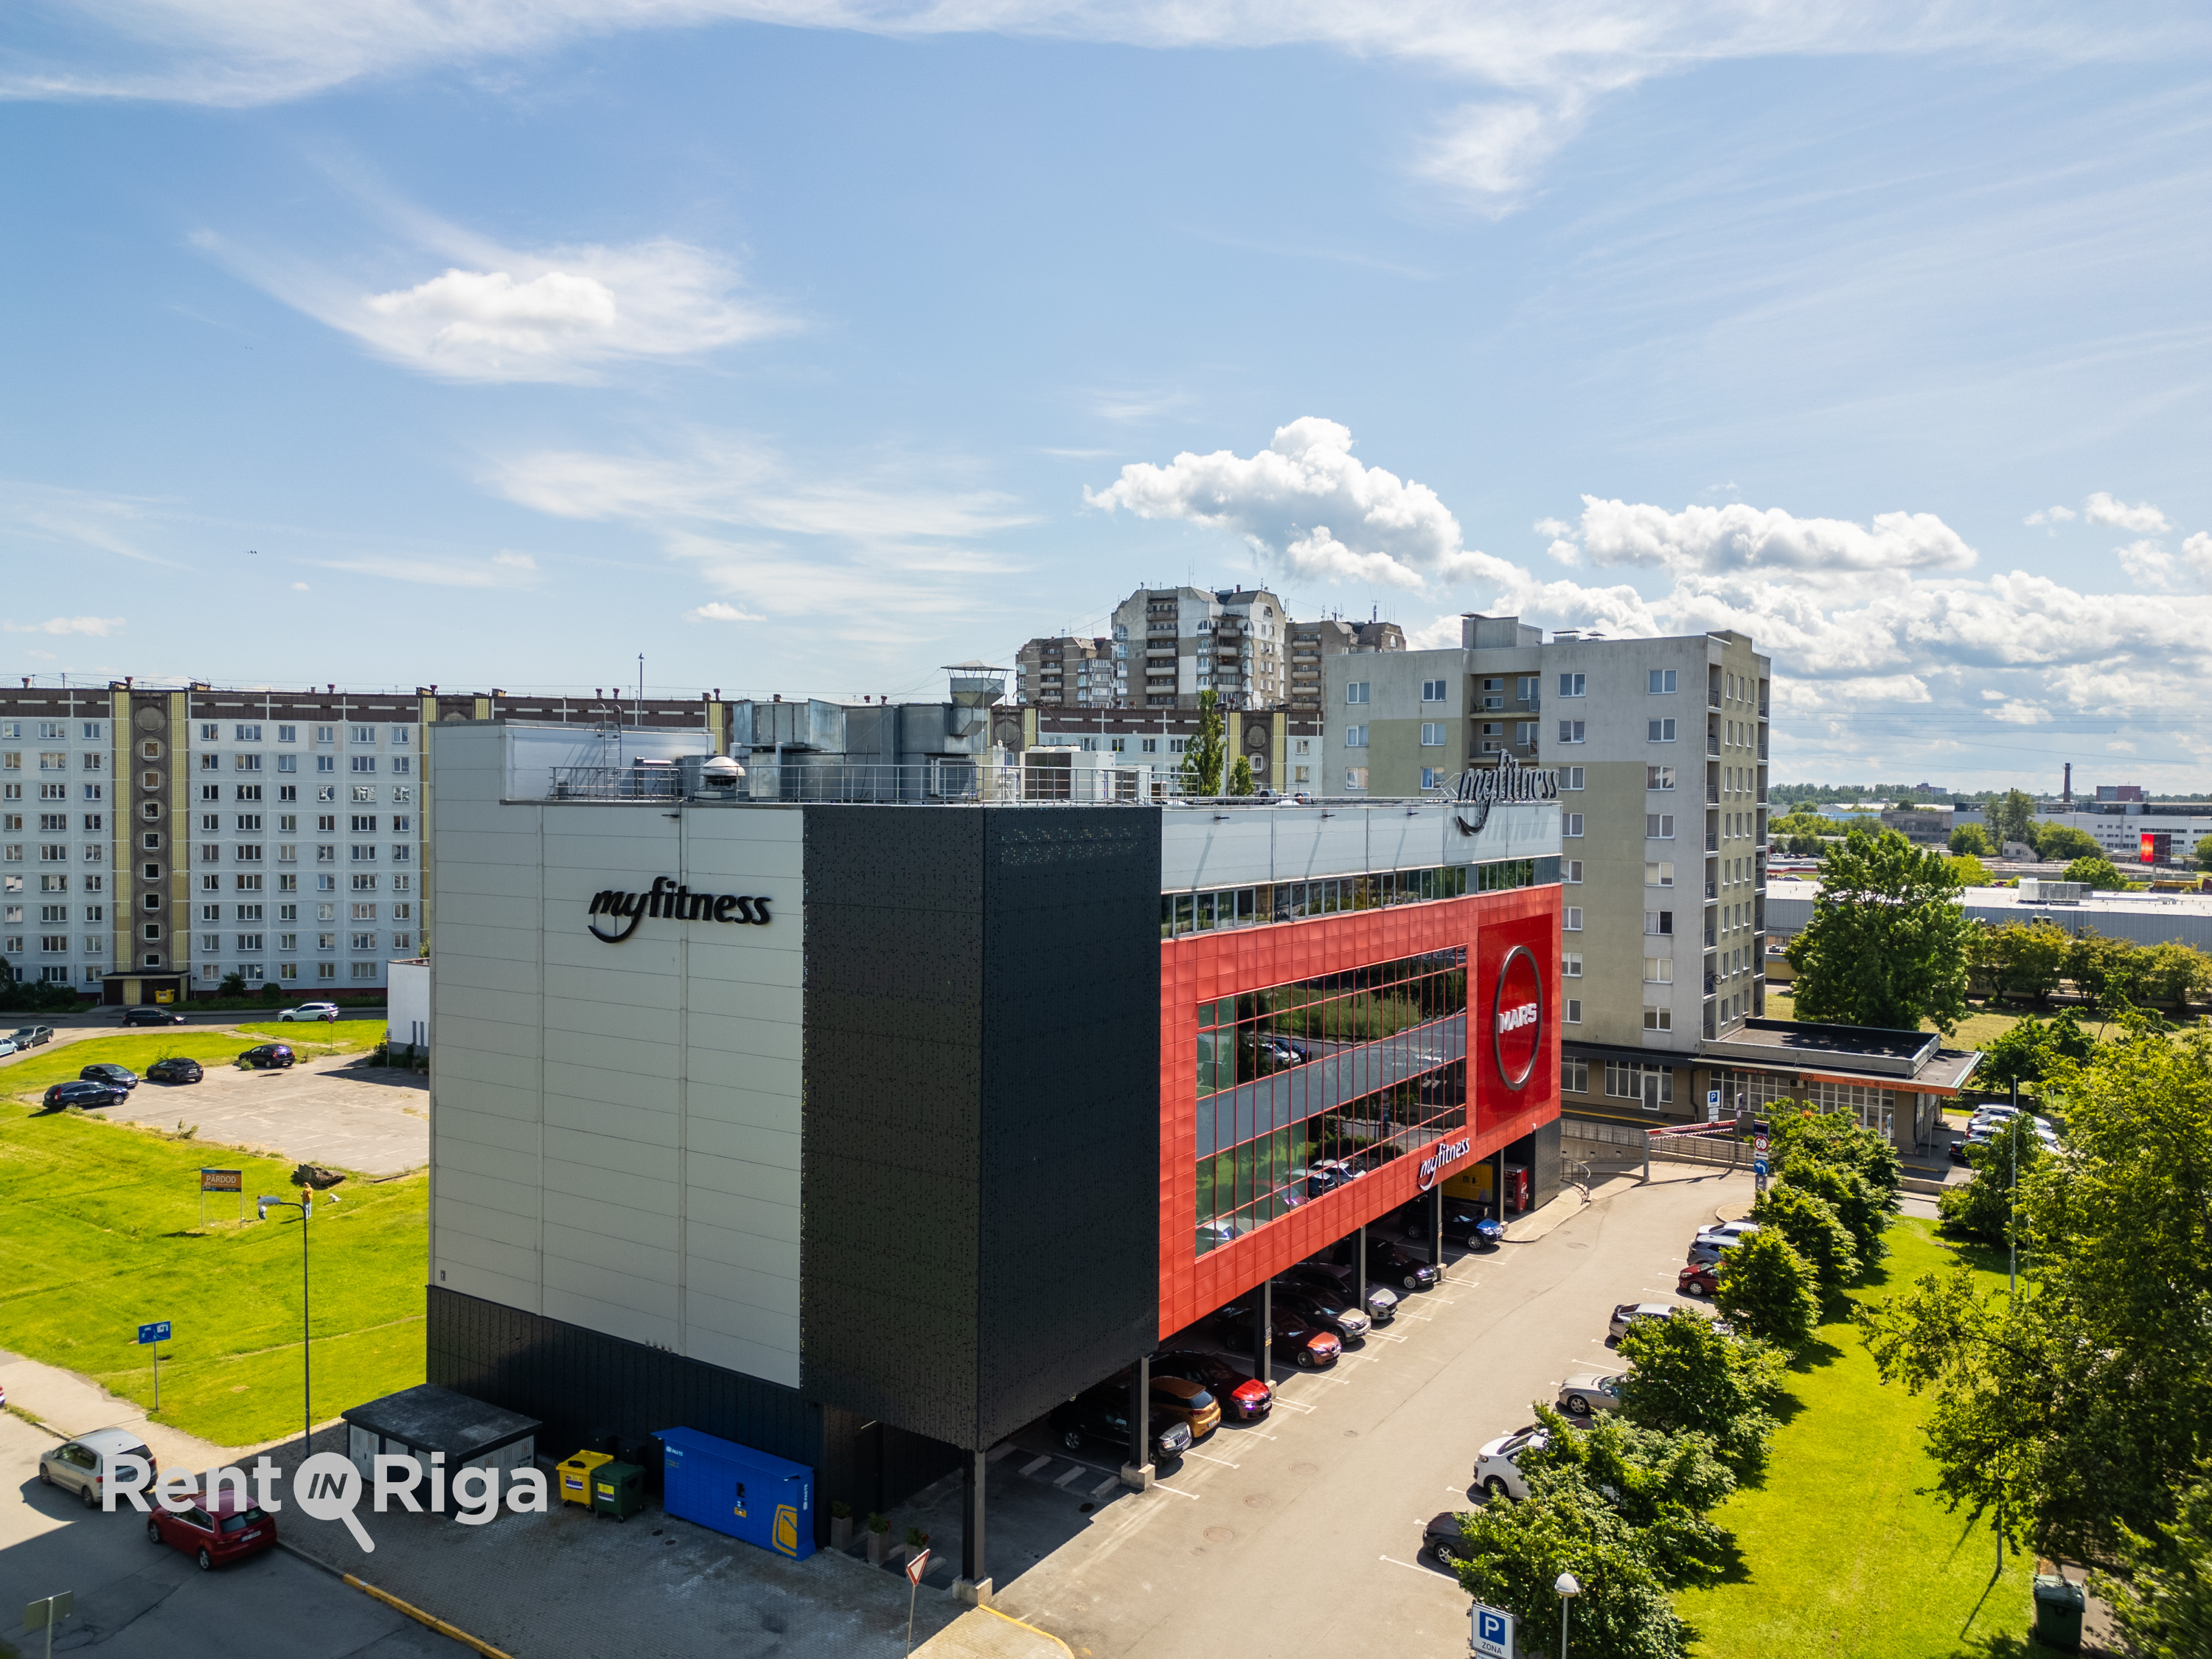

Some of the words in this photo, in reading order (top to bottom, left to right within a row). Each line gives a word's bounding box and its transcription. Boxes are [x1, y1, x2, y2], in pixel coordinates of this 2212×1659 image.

[1456, 748, 1559, 835] myfitness
[588, 876, 771, 943] myfitness
[1498, 1003, 1537, 1034] MARS
[1844, 1078, 1860, 1086] Spray
[1711, 1093, 1716, 1102] P
[1419, 1138, 1470, 1191] myfitness
[206, 1174, 237, 1183] PĀRDOD
[1485, 1615, 1500, 1637] P
[1481, 1641, 1502, 1655] ZONA
